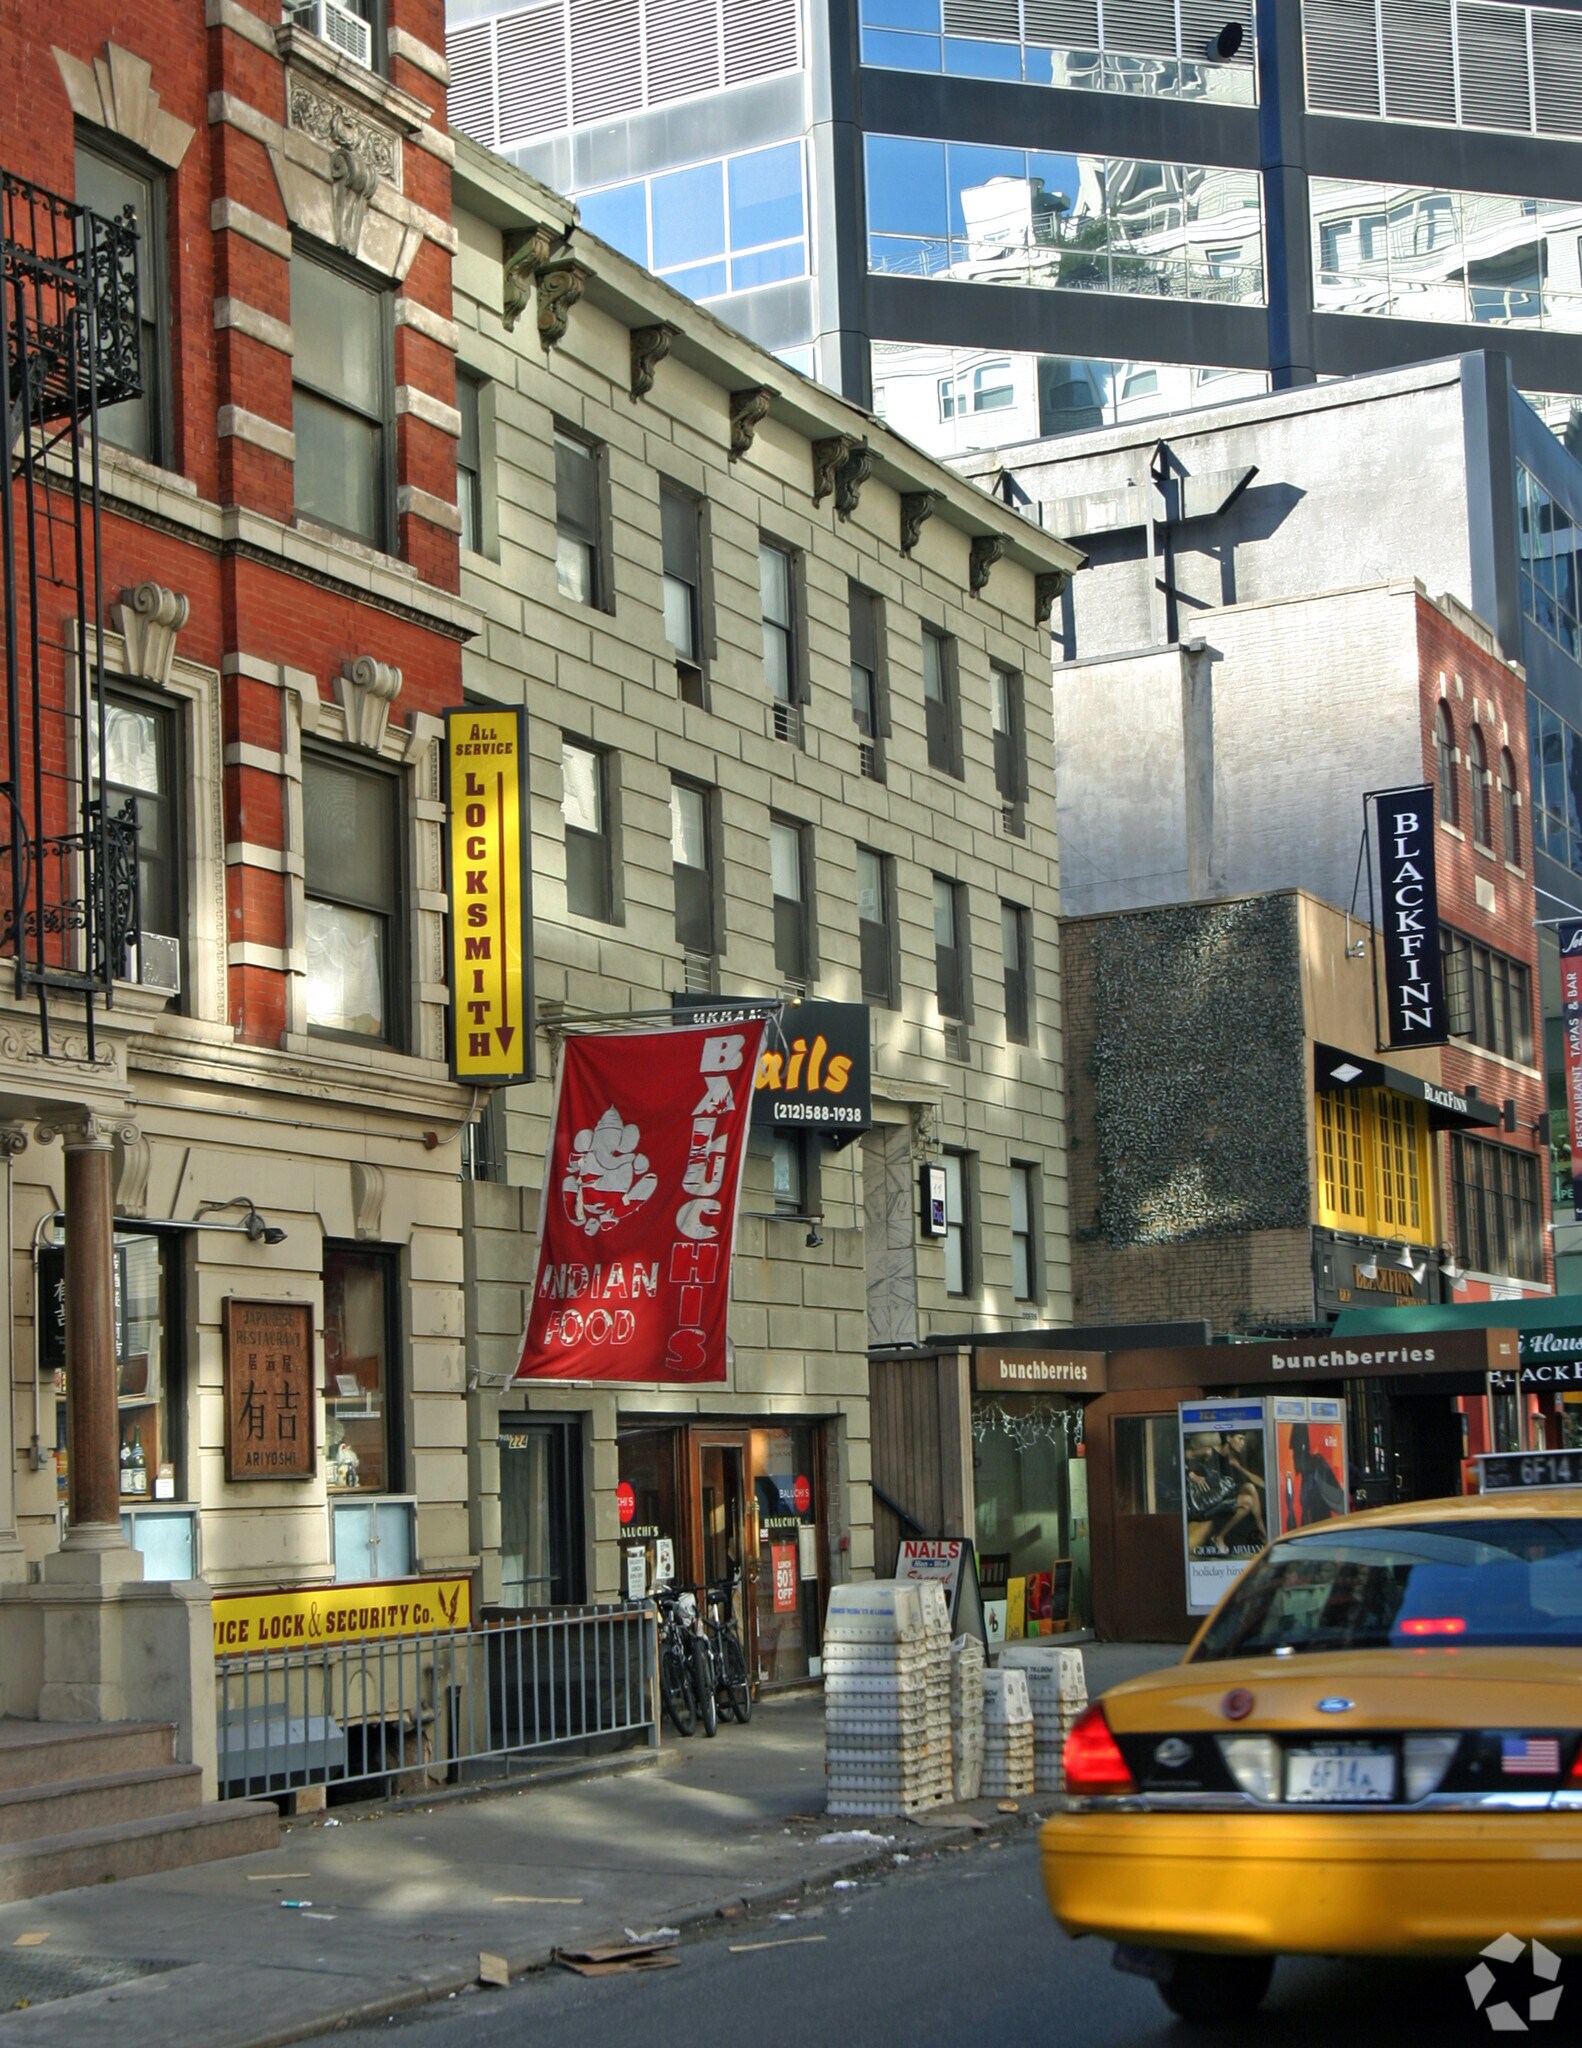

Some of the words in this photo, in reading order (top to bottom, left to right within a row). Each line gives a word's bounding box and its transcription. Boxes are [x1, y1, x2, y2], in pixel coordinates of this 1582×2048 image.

[455, 742, 513, 756] SERVICE
[464, 772, 492, 1057] LOCKSMITH
[1392, 811, 1434, 1032] BLACKFINN
[1566, 972, 1577, 997] BAR
[1568, 1001, 1578, 1011] &
[1568, 1018, 1580, 1058] TAPAS
[774, 1102, 862, 1123] (212)588-1938
[539, 1262, 660, 1300] INDIAN
[243, 1310, 296, 1328] JAPANESE
[544, 1309, 635, 1345] FOOD
[236, 1330, 300, 1347] RESTAURANT
[1271, 1347, 1436, 1370] bunchberries
[999, 1360, 1088, 1381] bunchberries
[239, 1380, 300, 1442] 有吉
[245, 1451, 296, 1467] ARIYOSHI
[1521, 1457, 1571, 1485] 6F14
[779, 1488, 810, 1499] BALUCHI'S
[764, 1516, 802, 1528] BALUCHI'S
[1192, 1565, 1225, 1577] holiday
[777, 1587, 793, 1601] OFF
[258, 1613, 305, 1640] LOCK
[308, 1600, 322, 1638] &
[325, 1604, 409, 1634] SECURITY
